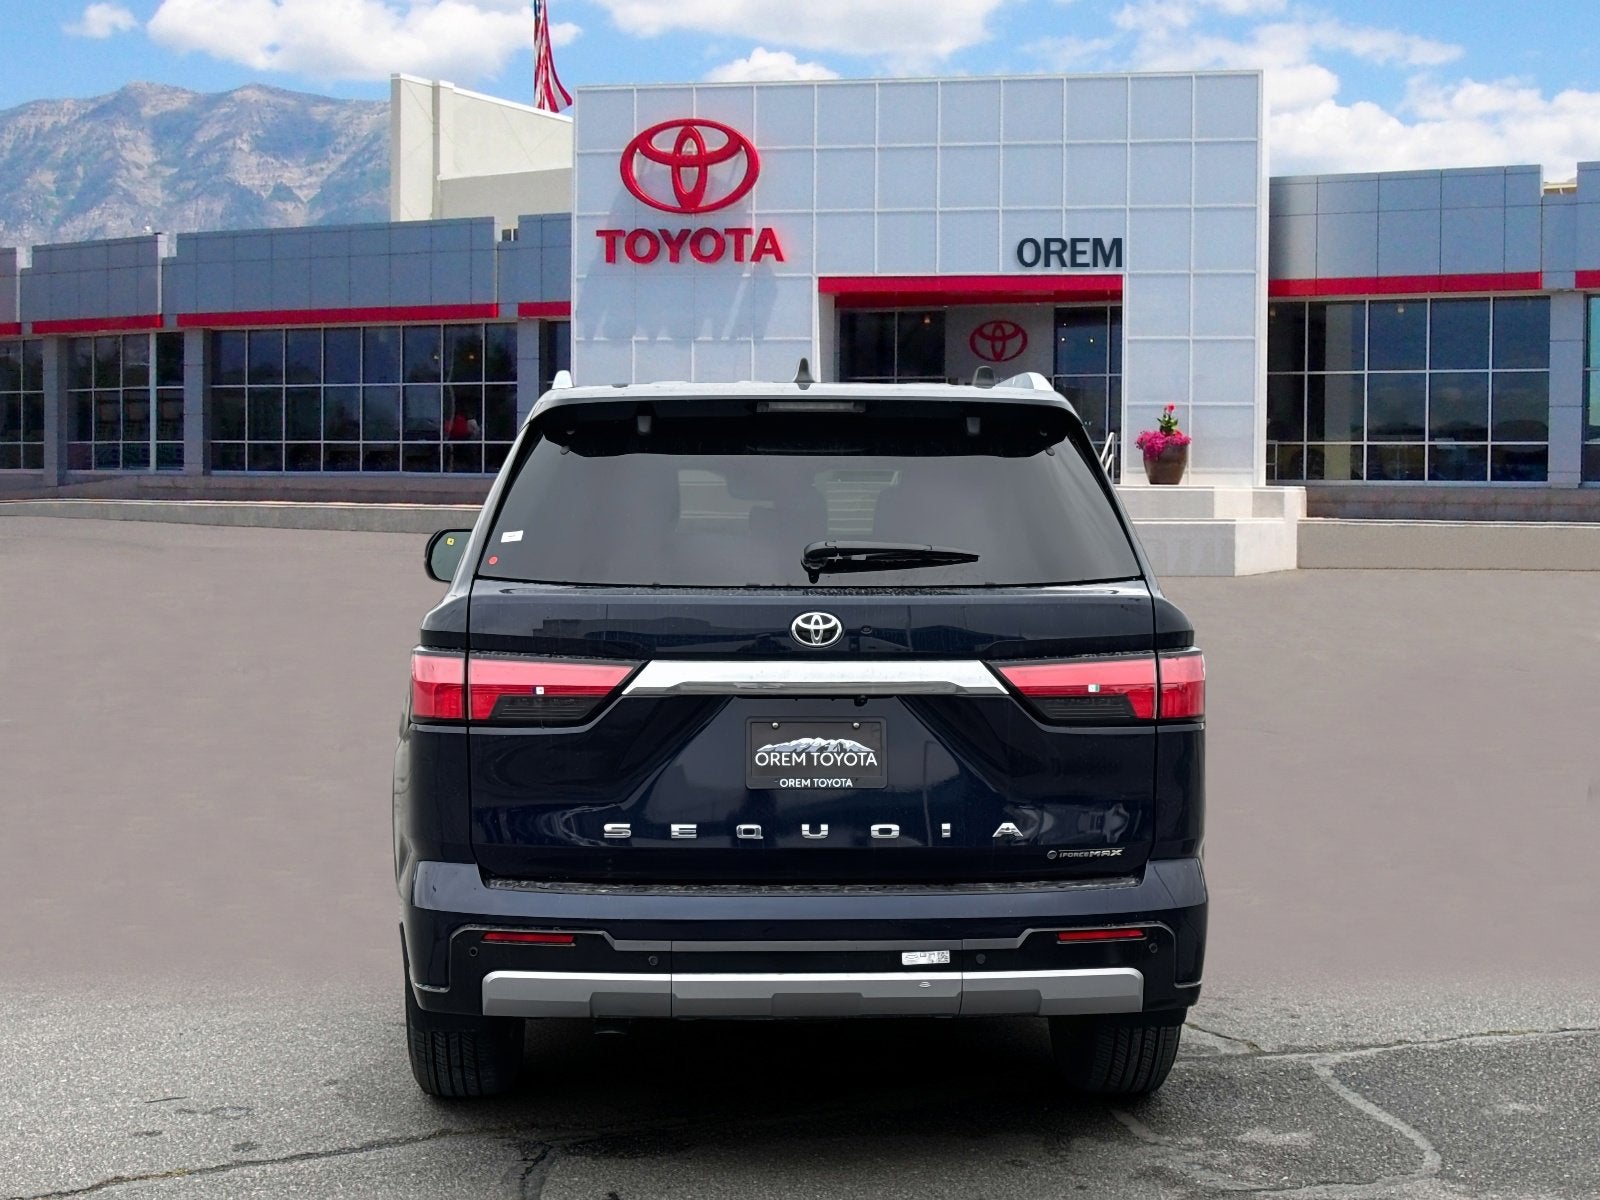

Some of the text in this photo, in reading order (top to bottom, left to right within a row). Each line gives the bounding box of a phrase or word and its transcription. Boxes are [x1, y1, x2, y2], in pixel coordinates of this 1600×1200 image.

[596, 227, 785, 264] TOYOTA
[1016, 237, 1123, 267] OREM
[755, 752, 878, 766] OREM TOYOTA
[779, 778, 853, 788] OREM TOYOTA
[603, 823, 1024, 840] SEQUOIA
